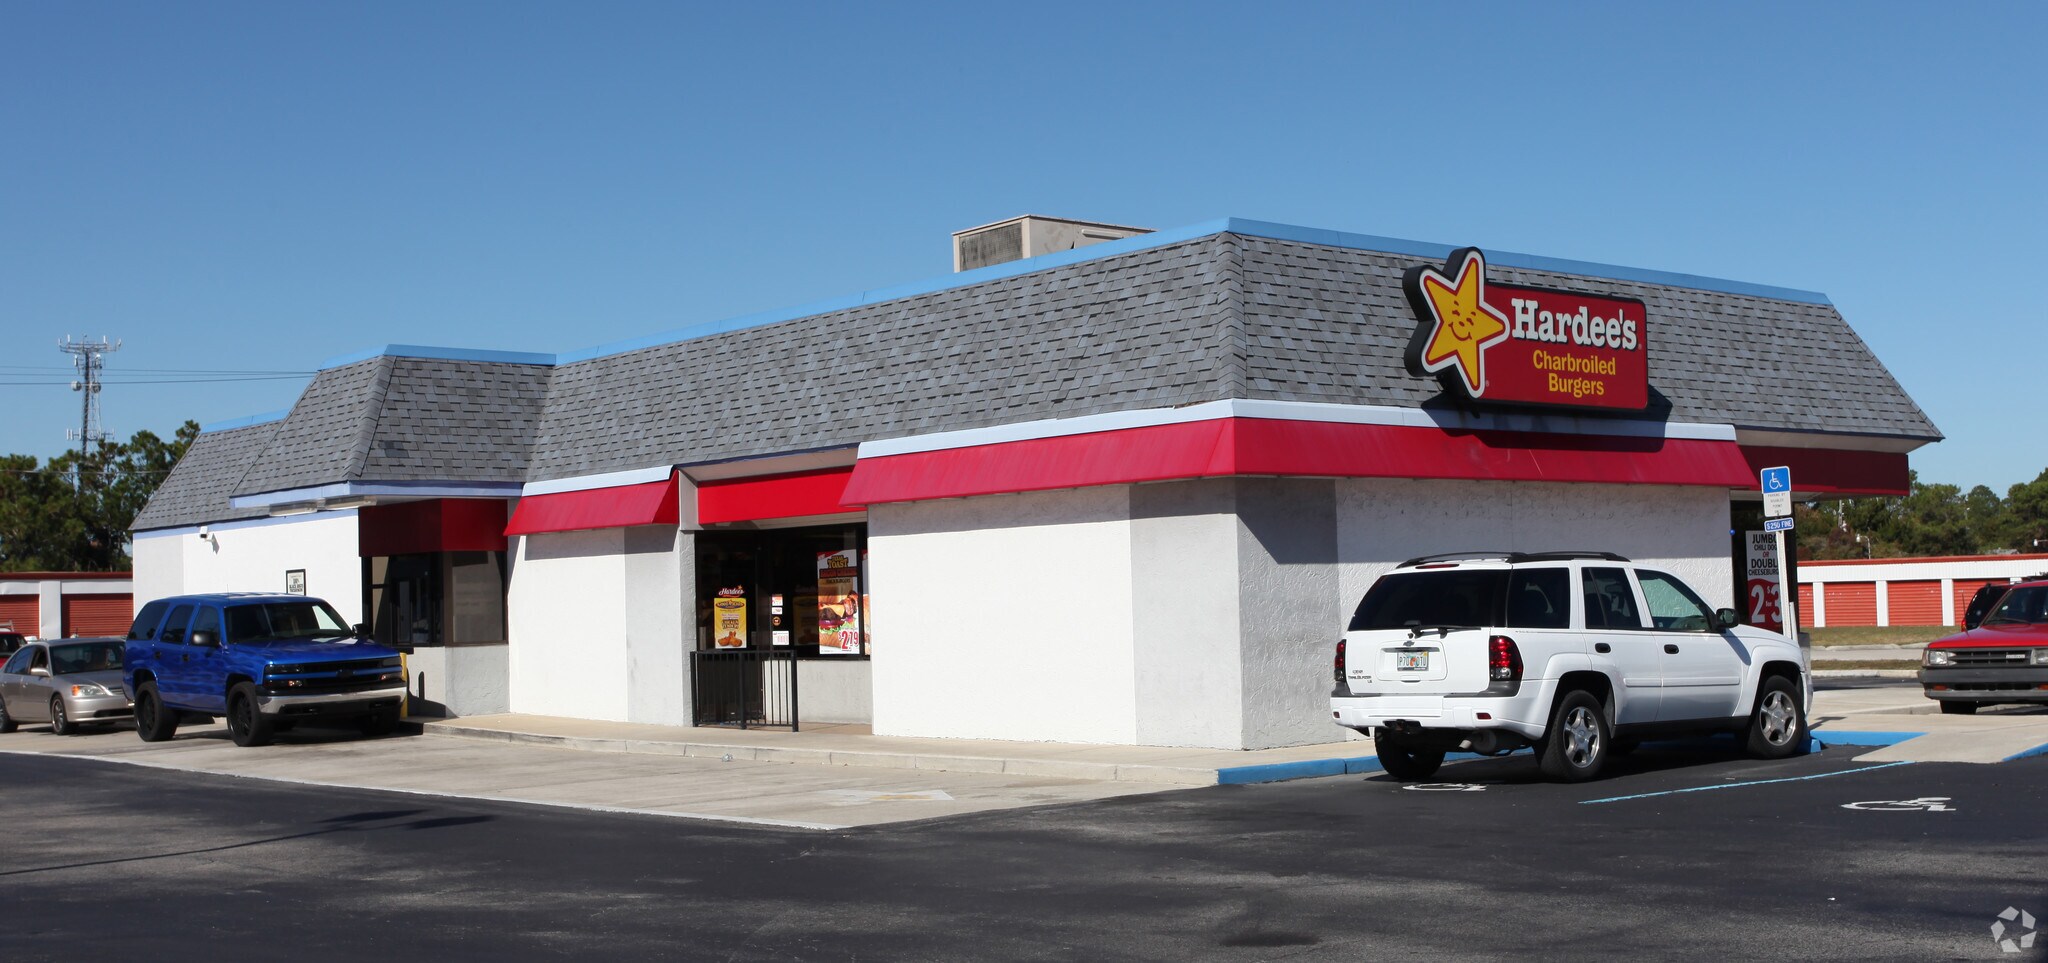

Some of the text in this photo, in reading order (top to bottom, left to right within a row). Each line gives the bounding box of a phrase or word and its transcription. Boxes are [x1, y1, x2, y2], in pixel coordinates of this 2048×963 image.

[1511, 298, 1637, 350] Hardee's
[1533, 350, 1616, 376] Charbroiled
[1549, 373, 1605, 398] Burgers
[1781, 520, 1792, 528] FINE
[827, 559, 848, 568] TOAST
[1751, 558, 1778, 569] DOUBL
[1751, 584, 1765, 623] 2
